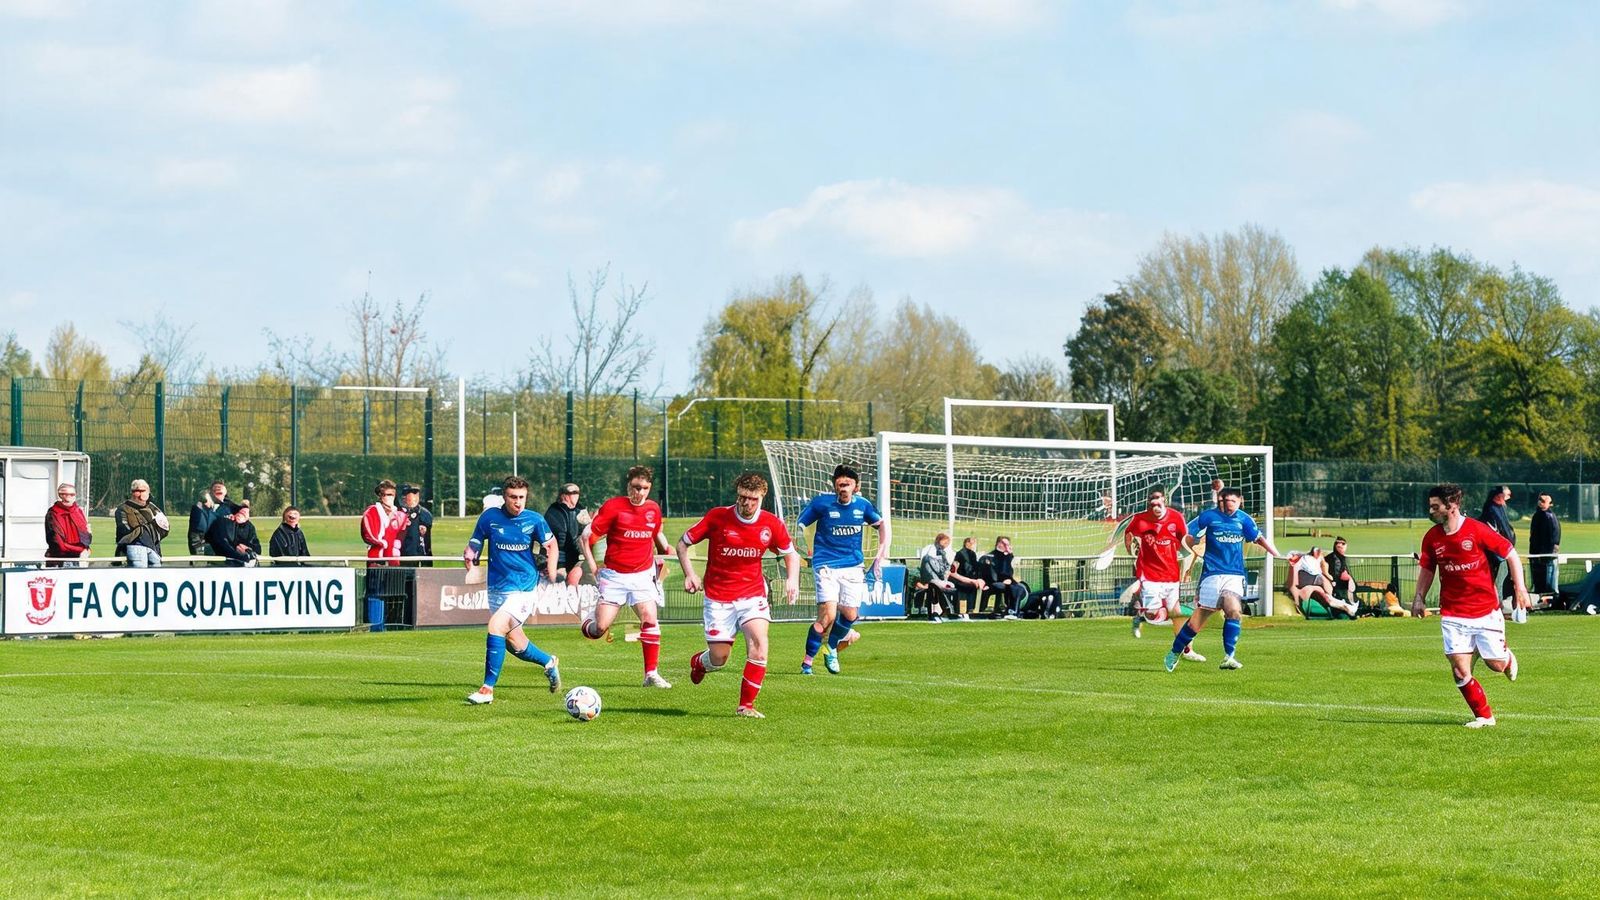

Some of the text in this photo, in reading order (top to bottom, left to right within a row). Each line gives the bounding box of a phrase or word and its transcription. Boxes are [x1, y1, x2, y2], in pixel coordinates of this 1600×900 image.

[68, 579, 344, 620] FA CUP QUALIFYING
